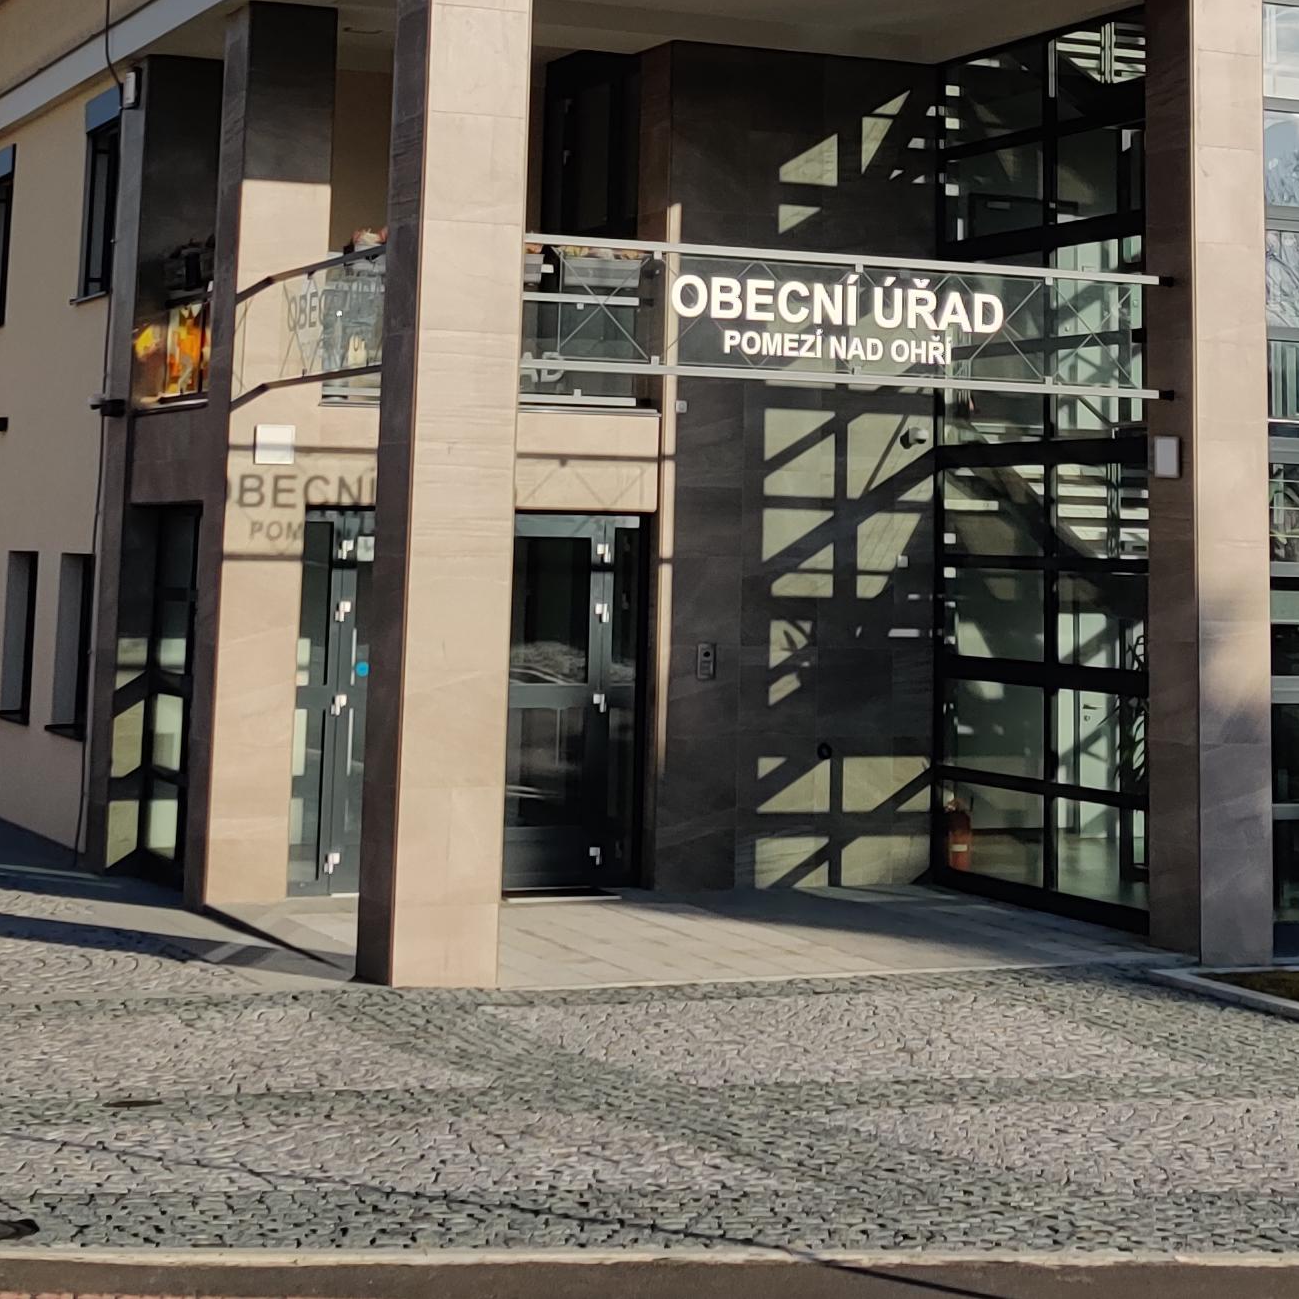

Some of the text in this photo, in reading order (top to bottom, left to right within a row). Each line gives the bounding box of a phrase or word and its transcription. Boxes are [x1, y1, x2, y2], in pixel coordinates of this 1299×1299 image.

[671, 274, 1003, 333] OBECNÍ ÚŘAD
[724, 329, 952, 365] POMEZÍ NAD OHŘÍ
